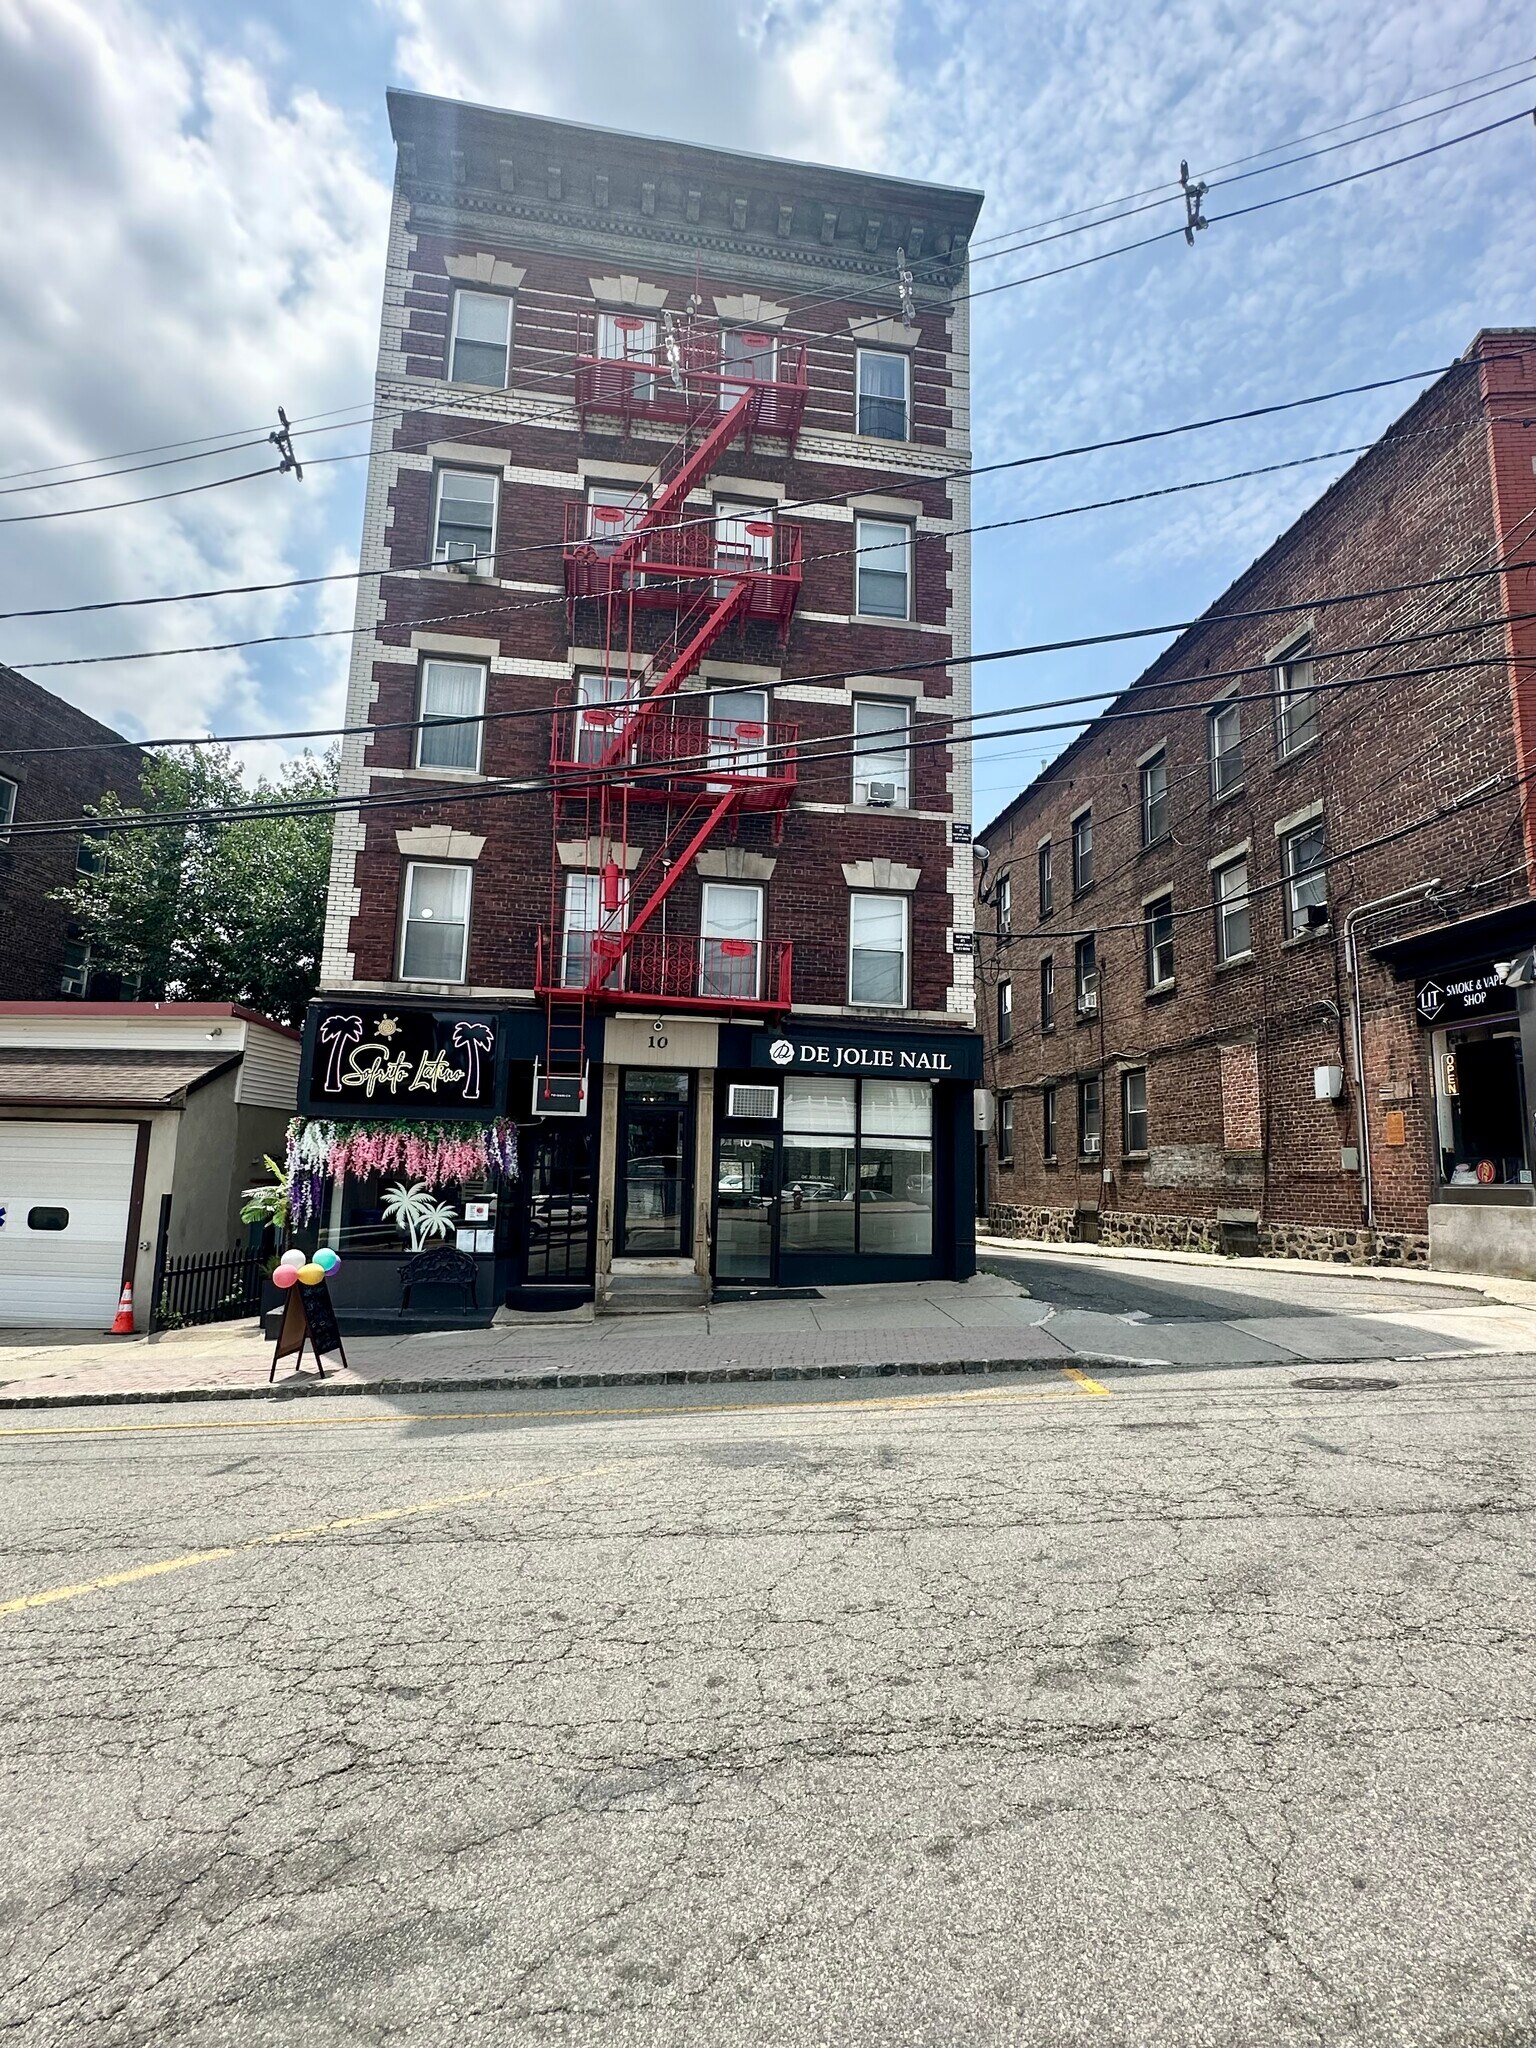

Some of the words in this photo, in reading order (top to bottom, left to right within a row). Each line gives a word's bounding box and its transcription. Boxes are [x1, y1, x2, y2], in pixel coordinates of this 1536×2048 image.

[1446, 980, 1474, 996] SMOKE
[1475, 979, 1482, 990] &
[1421, 990, 1439, 1008] LIT
[1463, 992, 1486, 1006] SHOP
[648, 1036, 668, 1048] 10
[800, 1045, 830, 1063] DE
[833, 1047, 894, 1068] JOLIE
[899, 1051, 952, 1070] NAIL
[341, 1043, 413, 1097] Sofrito
[408, 1049, 465, 1093] Latino
[1446, 1055, 1457, 1094] OPEN
